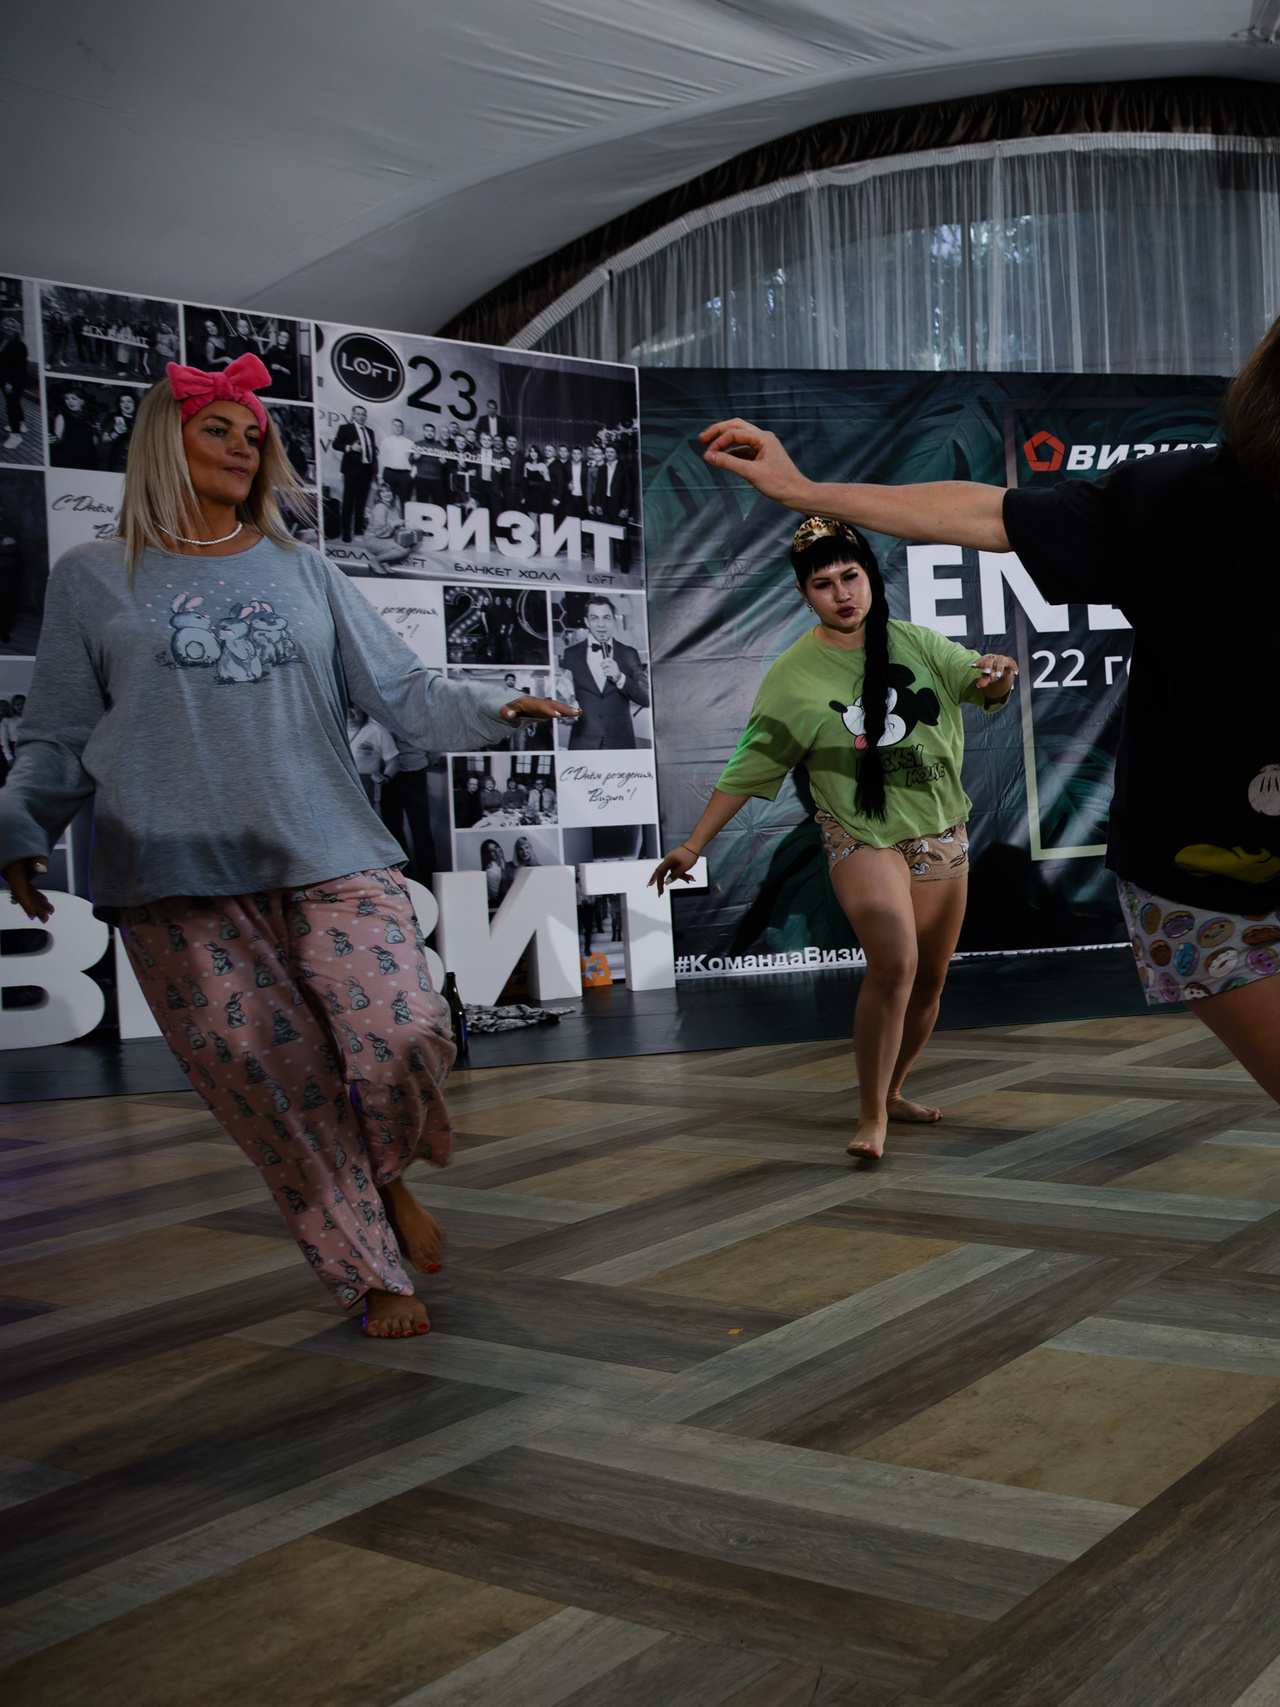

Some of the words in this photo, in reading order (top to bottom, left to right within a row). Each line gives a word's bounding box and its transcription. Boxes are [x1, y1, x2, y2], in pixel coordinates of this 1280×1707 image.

[341, 351, 397, 382] LOFT
[407, 355, 477, 421] 23
[404, 501, 628, 573] ВИЗИТ
[454, 562, 512, 578] БАНКЕТ
[518, 569, 561, 582] ХОЛЛ
[586, 574, 615, 585] LOFT
[1031, 649, 1088, 689] 22
[1104, 655, 1132, 686] г
[906, 762, 946, 788] MOUSE
